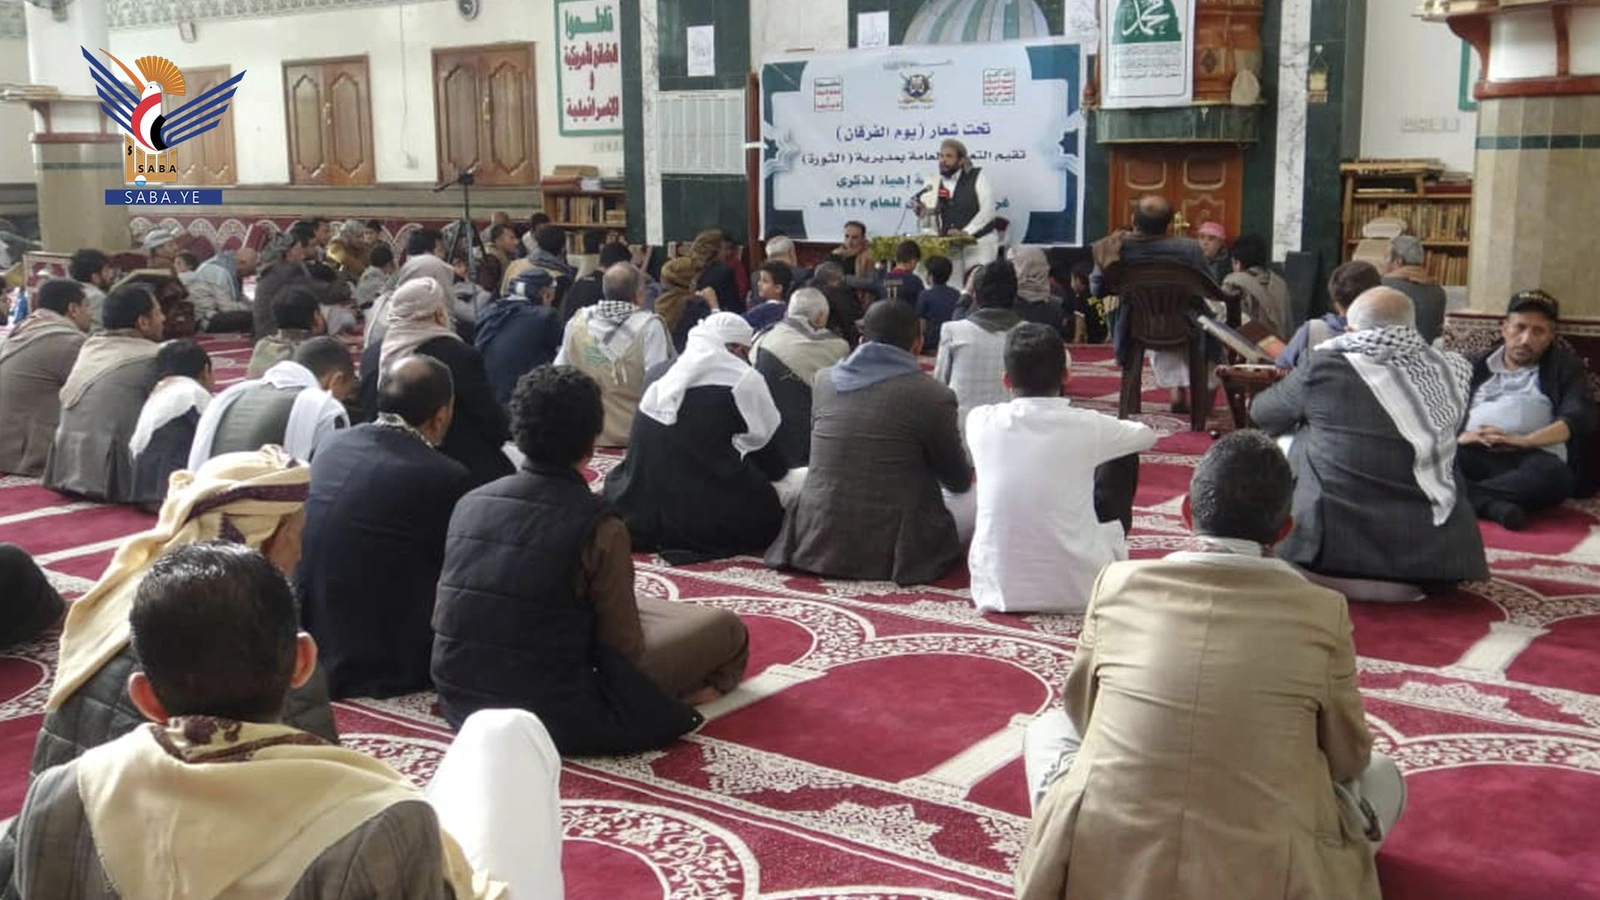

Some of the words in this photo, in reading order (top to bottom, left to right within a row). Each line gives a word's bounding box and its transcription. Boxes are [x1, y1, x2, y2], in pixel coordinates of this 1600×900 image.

[929, 124, 959, 139] شعار
[963, 122, 991, 136] تحت
[994, 150, 1026, 162] تقيم
[870, 196, 901, 211] للعام
